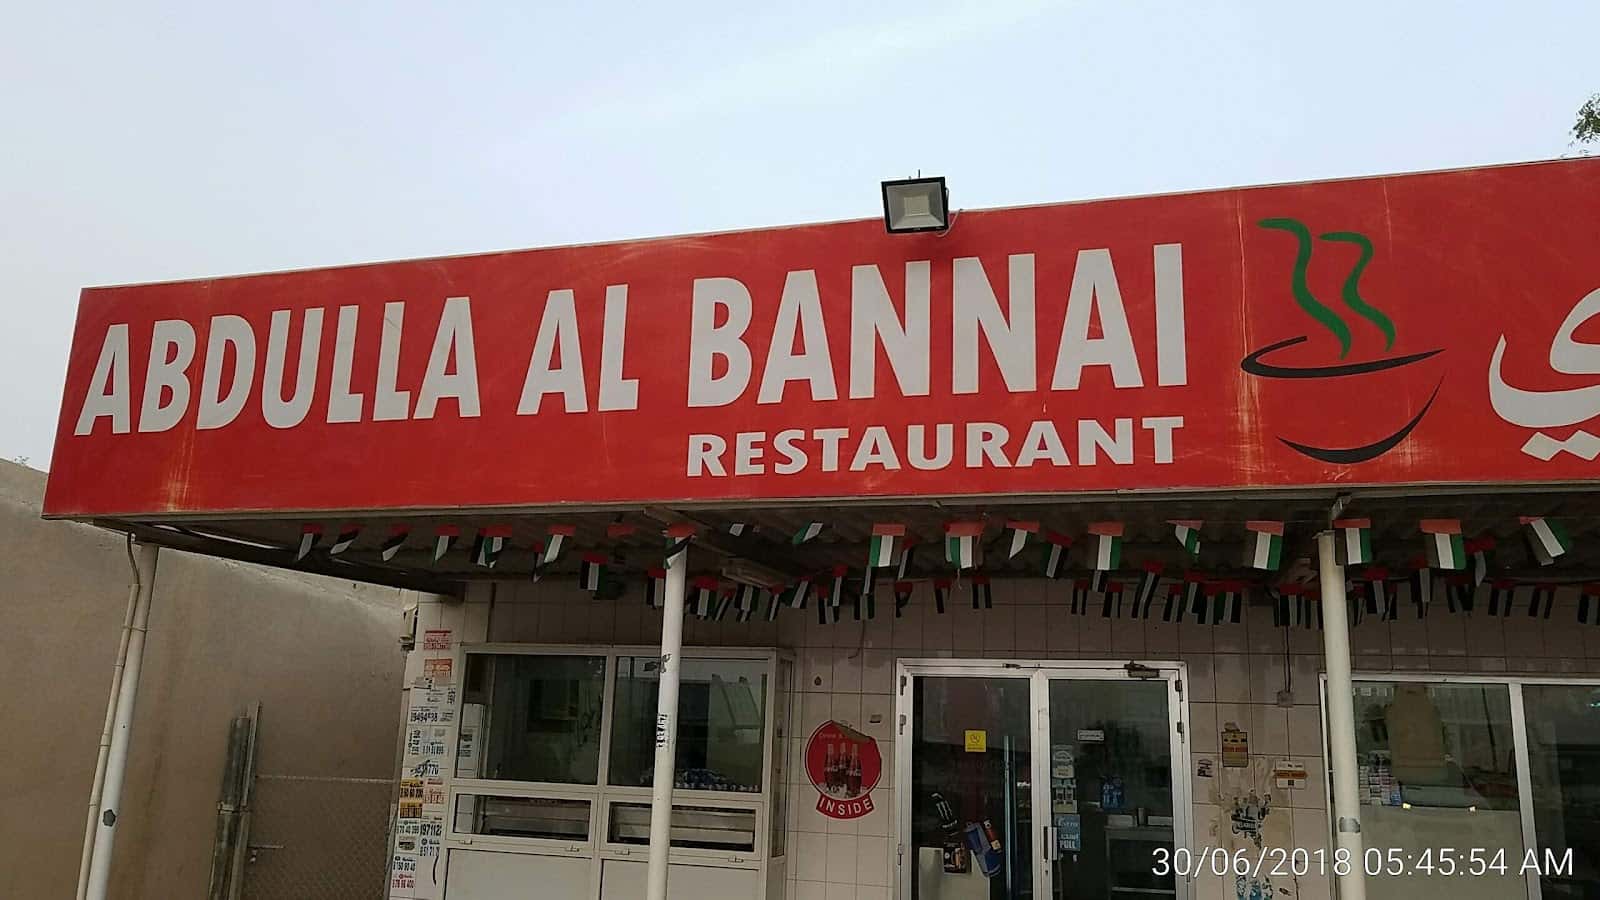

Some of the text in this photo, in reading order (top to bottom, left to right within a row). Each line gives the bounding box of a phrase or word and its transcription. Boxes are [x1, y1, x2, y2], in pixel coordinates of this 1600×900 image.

[75, 243, 1187, 436] ABDULLA AL BANNAI
[687, 416, 1184, 477] RESTAURANT
[819, 798, 873, 816] INSIDE
